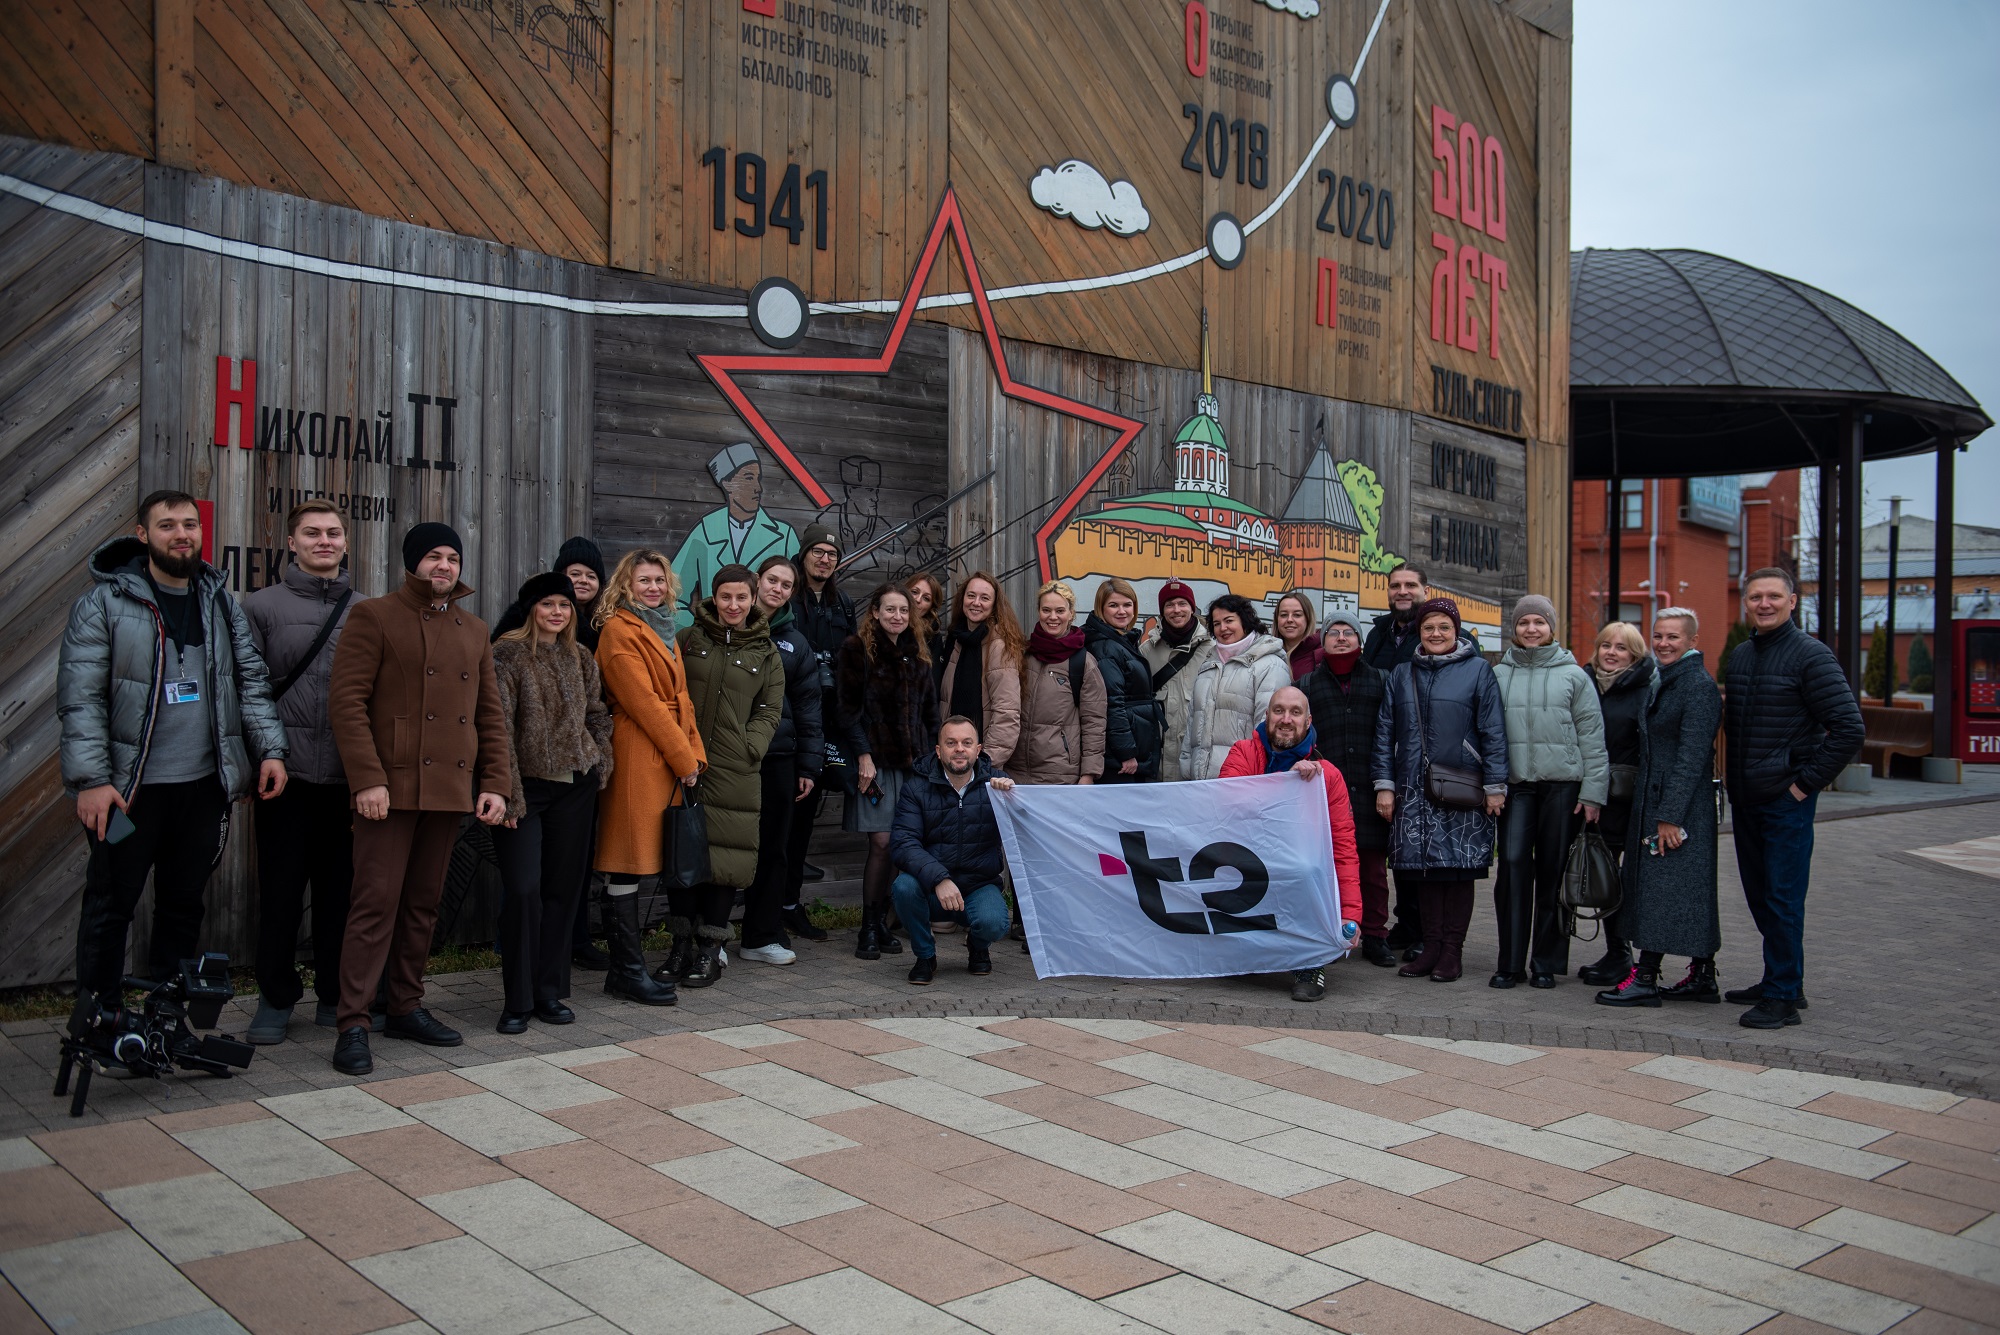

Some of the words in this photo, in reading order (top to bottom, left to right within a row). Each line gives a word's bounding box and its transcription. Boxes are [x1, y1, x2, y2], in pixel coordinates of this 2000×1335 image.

[741, 22, 870, 75] ИСТРЕБИТЕЛЬНЫХ
[783, 1, 814, 29] ШЛО
[820, 11, 887, 49] ОБУЧЕНИЕ
[741, 56, 832, 99] БАТАЛЬОНОВ
[1210, 39, 1264, 72] КАЗАНСКОЙ
[1210, 65, 1272, 100] НАБЕРЕЖНОЙ
[1182, 103, 1269, 190] 2018
[1432, 104, 1507, 243] 500
[703, 146, 828, 250] 1941
[1316, 169, 1395, 250] 2020
[1339, 289, 1382, 314] 500-ЛЕТИЯ
[1431, 232, 1507, 360] ЛЕТ
[1338, 313, 1381, 339] ТУЛЬСКОГО
[1338, 339, 1369, 361] КРЕМЛЯ
[1431, 365, 1523, 433] ТУЛЬСКОГО
[1431, 440, 1497, 502] КРЕМЛЯ
[269, 487, 282, 514] И
[1431, 514, 1443, 562] В
[1446, 519, 1501, 574] ЛИЦАХ
[1098, 831, 1278, 935] t2
